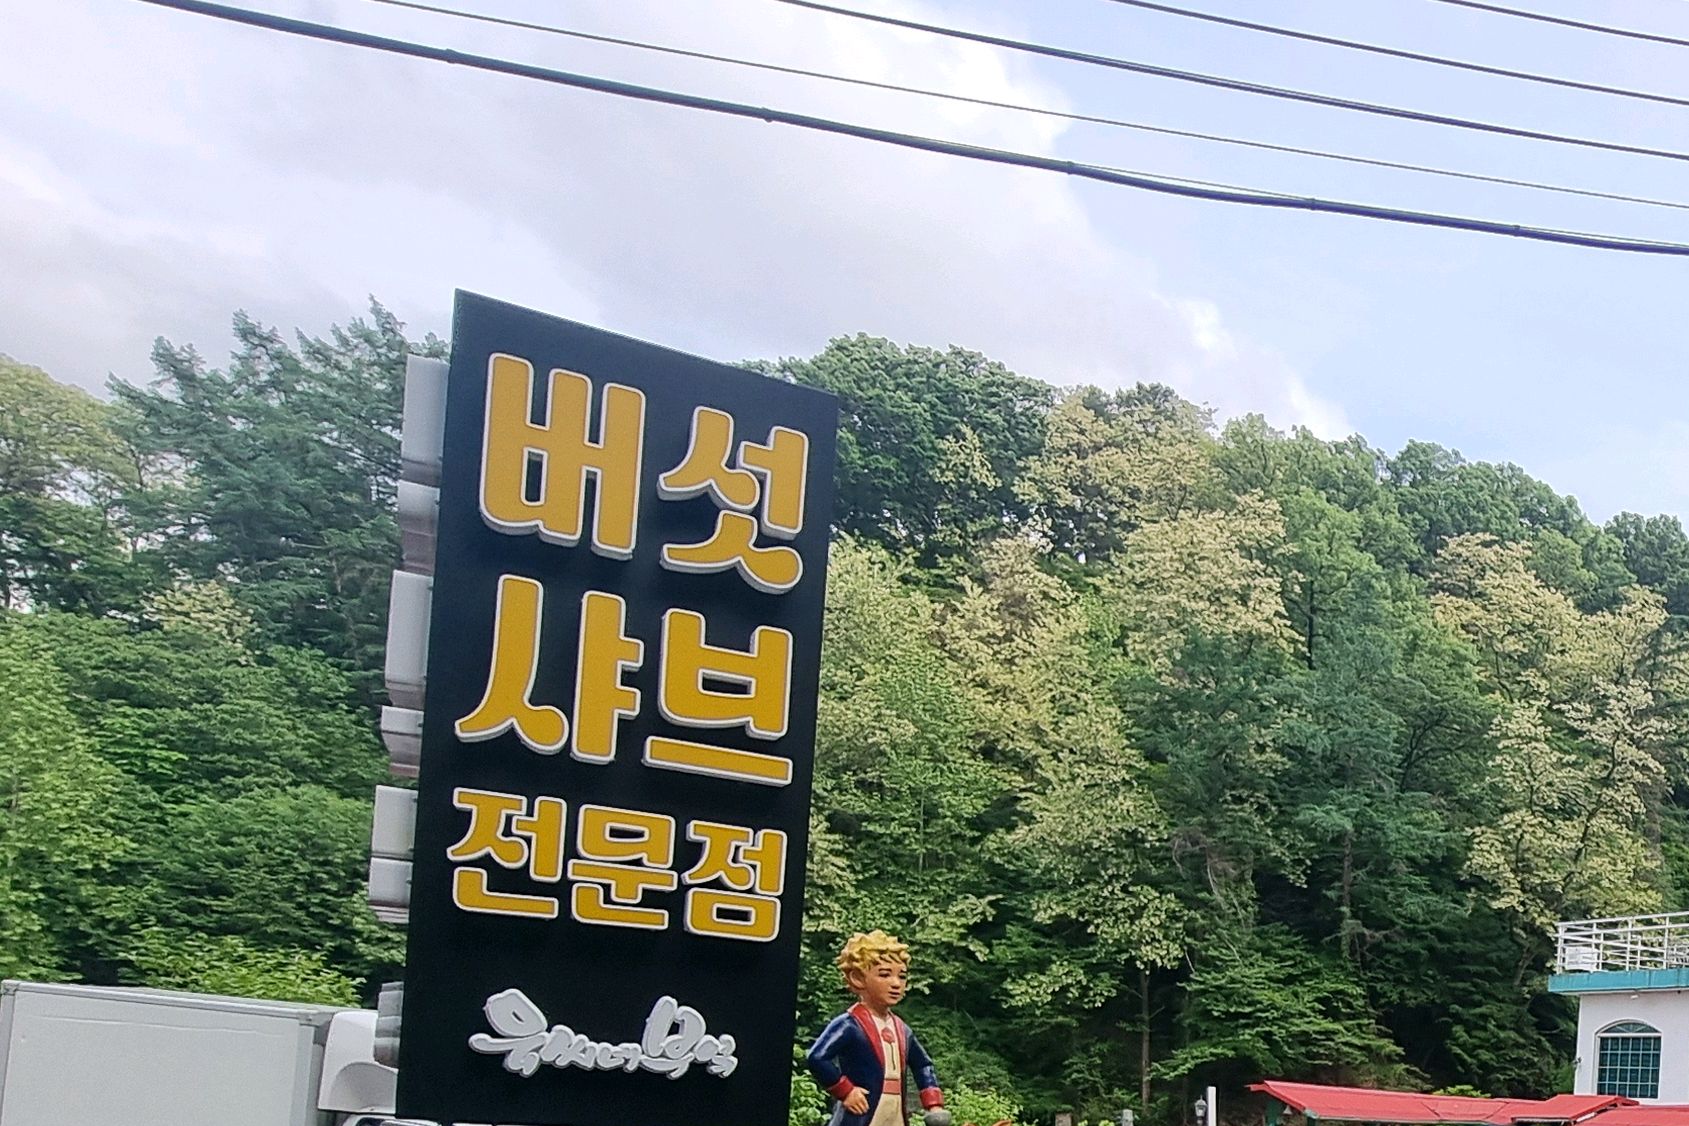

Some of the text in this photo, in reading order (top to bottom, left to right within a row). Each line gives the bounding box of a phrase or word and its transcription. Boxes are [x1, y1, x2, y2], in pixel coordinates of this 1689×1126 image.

[479, 352, 811, 595] 버섯
[455, 573, 793, 786] 샤브
[448, 786, 788, 942] 전문점
